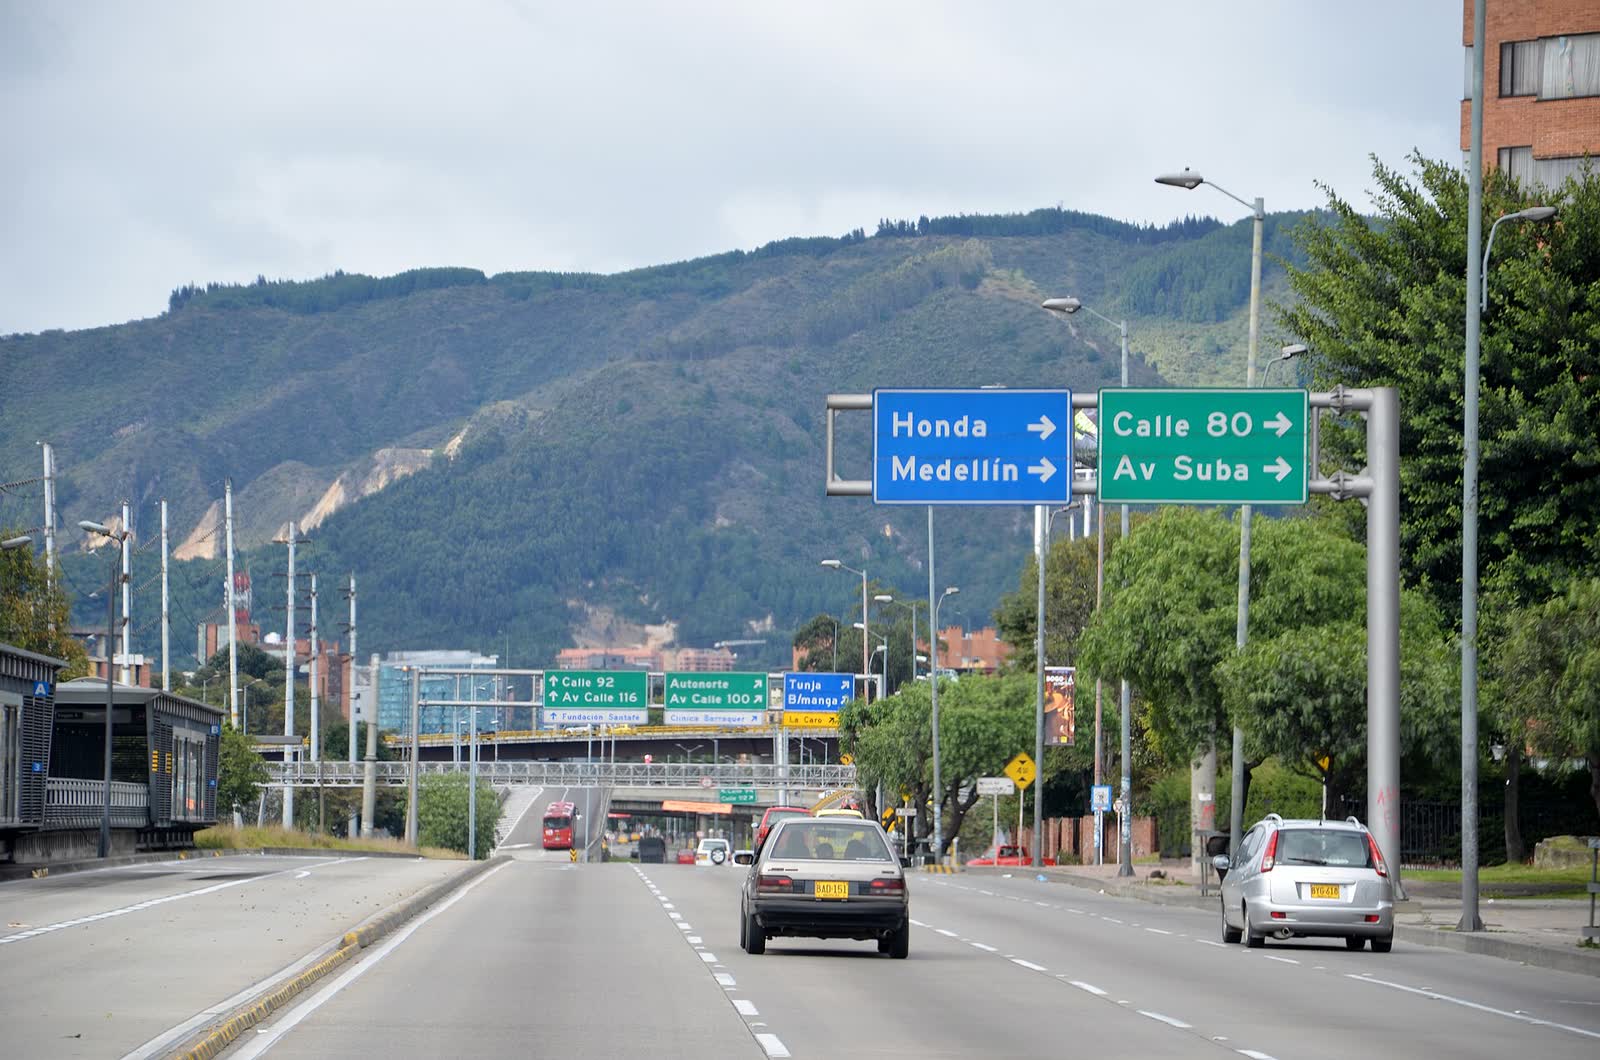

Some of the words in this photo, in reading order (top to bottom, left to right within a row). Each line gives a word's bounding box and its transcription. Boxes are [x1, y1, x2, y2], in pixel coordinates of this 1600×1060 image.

[892, 411, 988, 438] Honda
[1112, 411, 1190, 437] Calle
[1206, 411, 1253, 437] 80
[891, 455, 1019, 481] Medellín
[1112, 454, 1156, 481] Av
[1173, 455, 1249, 481] Suba
[561, 677, 592, 688] Calle
[596, 677, 615, 688] 92
[669, 678, 729, 689] Autonorte
[789, 679, 822, 693] Tunja
[34, 683, 47, 695] A
[562, 692, 579, 702] Av
[584, 692, 614, 703] Calle
[619, 692, 638, 703] 116
[669, 694, 687, 704] Av
[691, 694, 722, 704] Calle
[727, 694, 750, 704] 100
[788, 693, 838, 708] B/manga
[789, 716, 799, 724] La
[803, 716, 822, 724] Caro
[34, 763, 41, 771] 3
